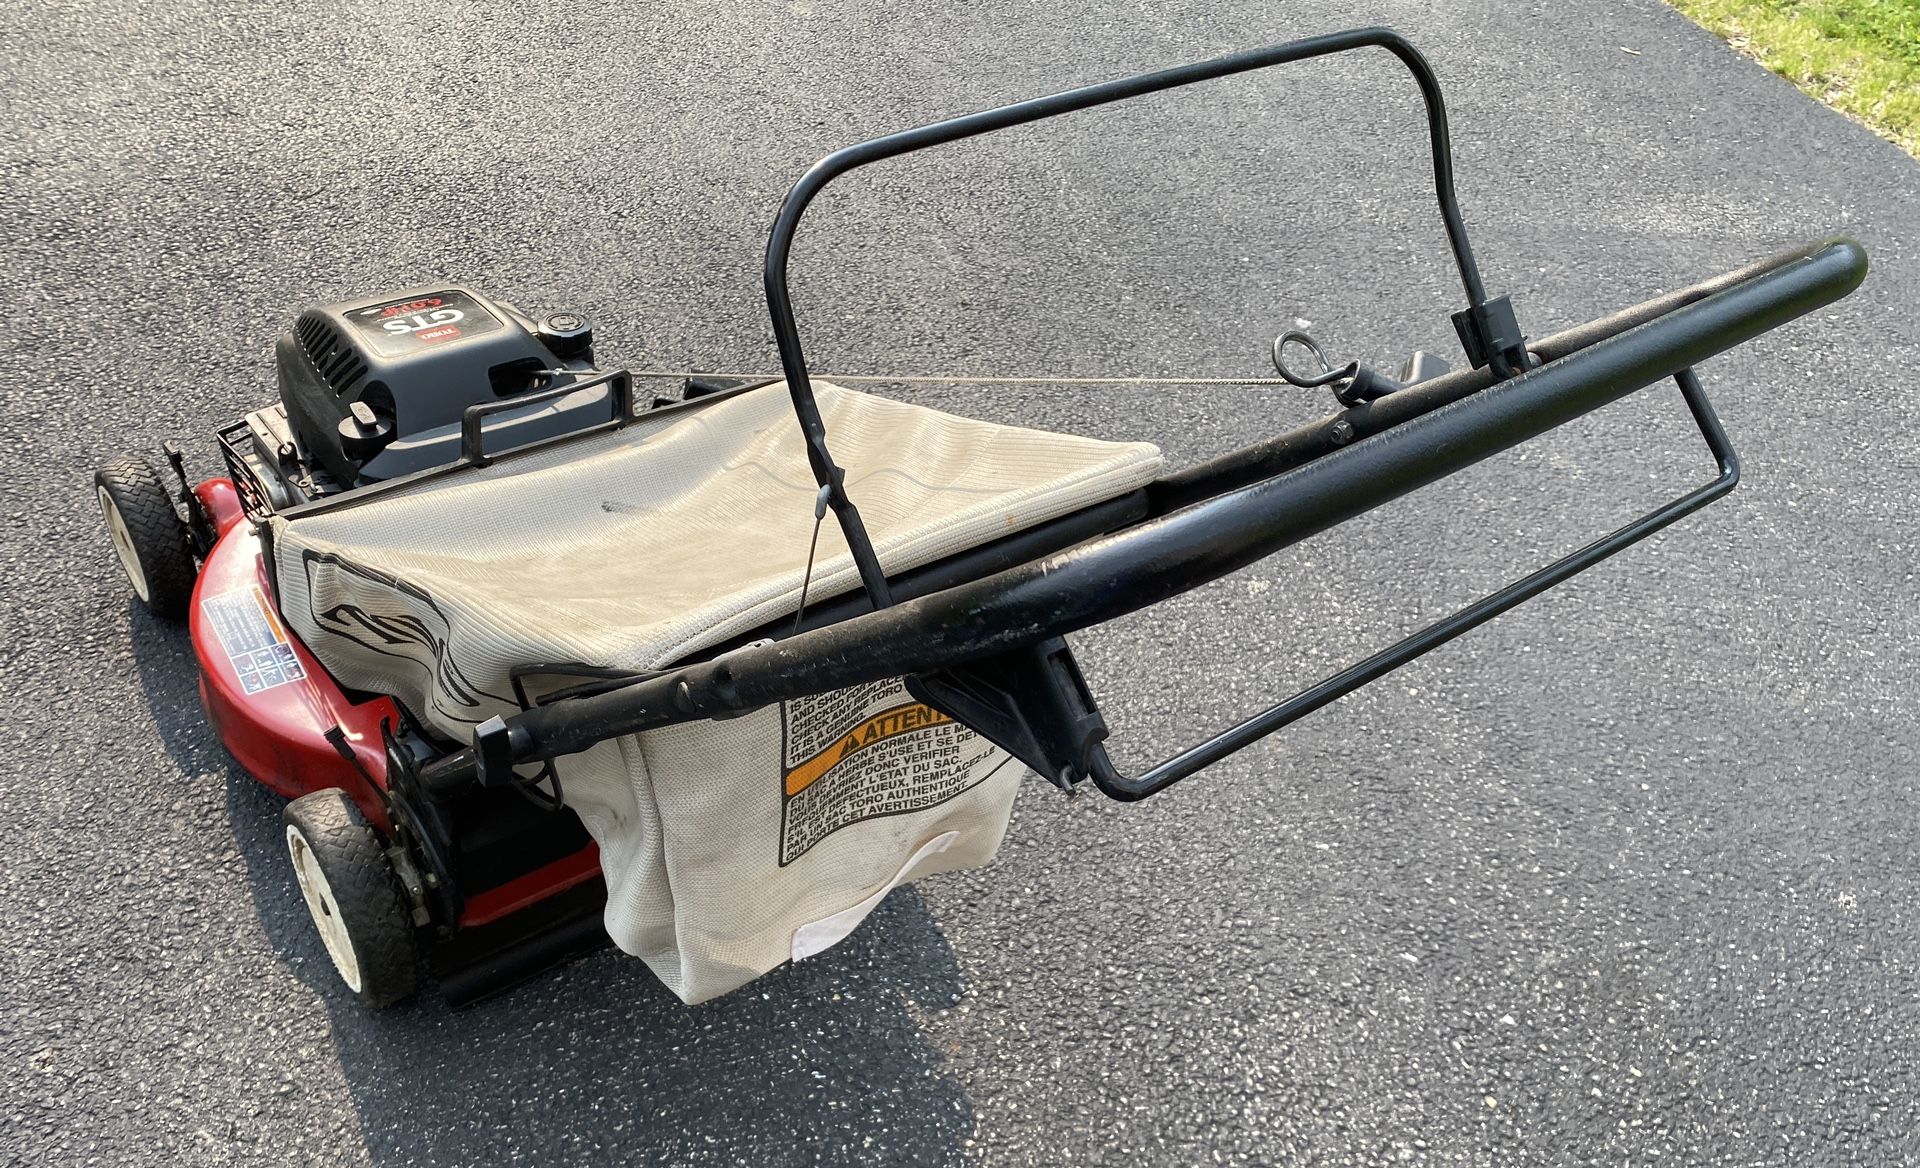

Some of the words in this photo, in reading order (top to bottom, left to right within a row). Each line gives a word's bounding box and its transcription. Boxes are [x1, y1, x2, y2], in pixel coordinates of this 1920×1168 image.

[383, 309, 465, 336] GTS
[421, 328, 457, 340] TORO
[790, 701, 801, 714] IS
[790, 743, 802, 755] IT
[804, 735, 814, 746] IS
[816, 730, 824, 740] A
[826, 702, 869, 734] GENUINE
[871, 685, 902, 703] TORO
[791, 716, 829, 745] CHECK
[831, 704, 851, 721] ANY
[854, 675, 905, 702] REPLACE
[791, 706, 814, 725] AND
[791, 700, 844, 735] CHECKED
[789, 802, 817, 825] VOUS
[819, 773, 862, 805] DEVRIEZ
[865, 758, 899, 775] DONC
[904, 746, 960, 765] VERIFIER
[790, 746, 816, 764] THIS
[790, 804, 804, 817] DU
[808, 785, 827, 802] SAC
[829, 780, 836, 789] A
[838, 756, 875, 781] HERBE
[878, 744, 914, 762] S'USE
[918, 740, 933, 751] ET
[936, 737, 953, 747] SE
[791, 793, 805, 809] EN
[808, 751, 869, 796] UTILISATION
[871, 729, 932, 754] NORMALE
[935, 727, 951, 736] LE
[869, 766, 910, 784] L'ETAT
[913, 762, 930, 773] DU
[935, 756, 962, 769] SAC.
[786, 835, 807, 853] PAR
[810, 823, 823, 837] UN
[825, 806, 847, 824] SAC
[850, 794, 883, 809] TORO
[887, 769, 970, 801] AUTHENTIQUE
[786, 844, 804, 861] QUI
[807, 819, 840, 848] PORTE
[842, 808, 866, 823] CET
[868, 781, 968, 815] AVERTISSEMENT.
[787, 827, 805, 844] S'IL
[808, 812, 828, 829] EST
[829, 780, 909, 812] DEFECTUEUX,
[913, 745, 996, 785] REMPLACEZ-LE
